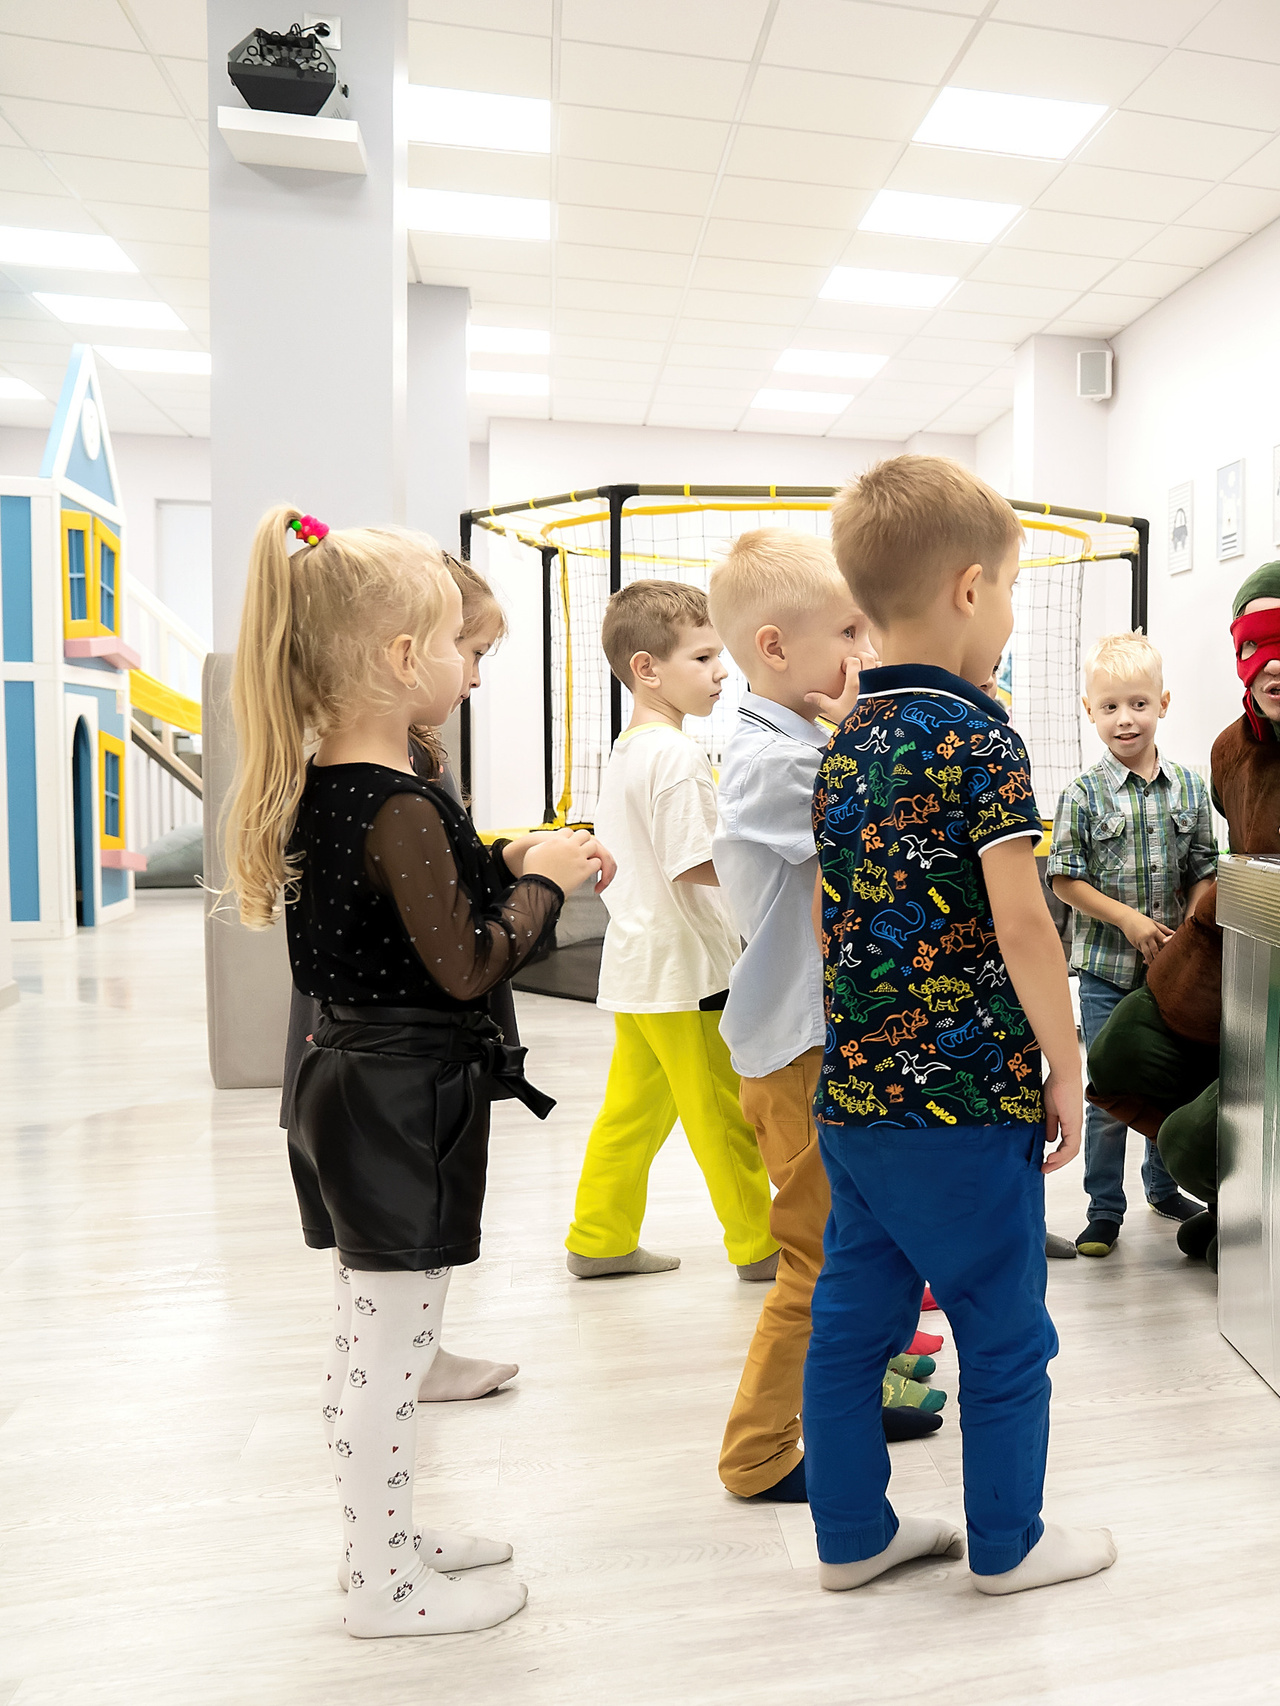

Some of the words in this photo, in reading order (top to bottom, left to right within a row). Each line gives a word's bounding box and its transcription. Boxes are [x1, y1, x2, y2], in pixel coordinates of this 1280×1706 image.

[861, 823, 878, 841] RO
[865, 836, 885, 853] AR
[927, 886, 950, 913] DINO
[870, 958, 896, 979] DINO
[840, 1040, 859, 1058] RO
[848, 1052, 868, 1070] AR
[925, 1100, 958, 1125] DINO
